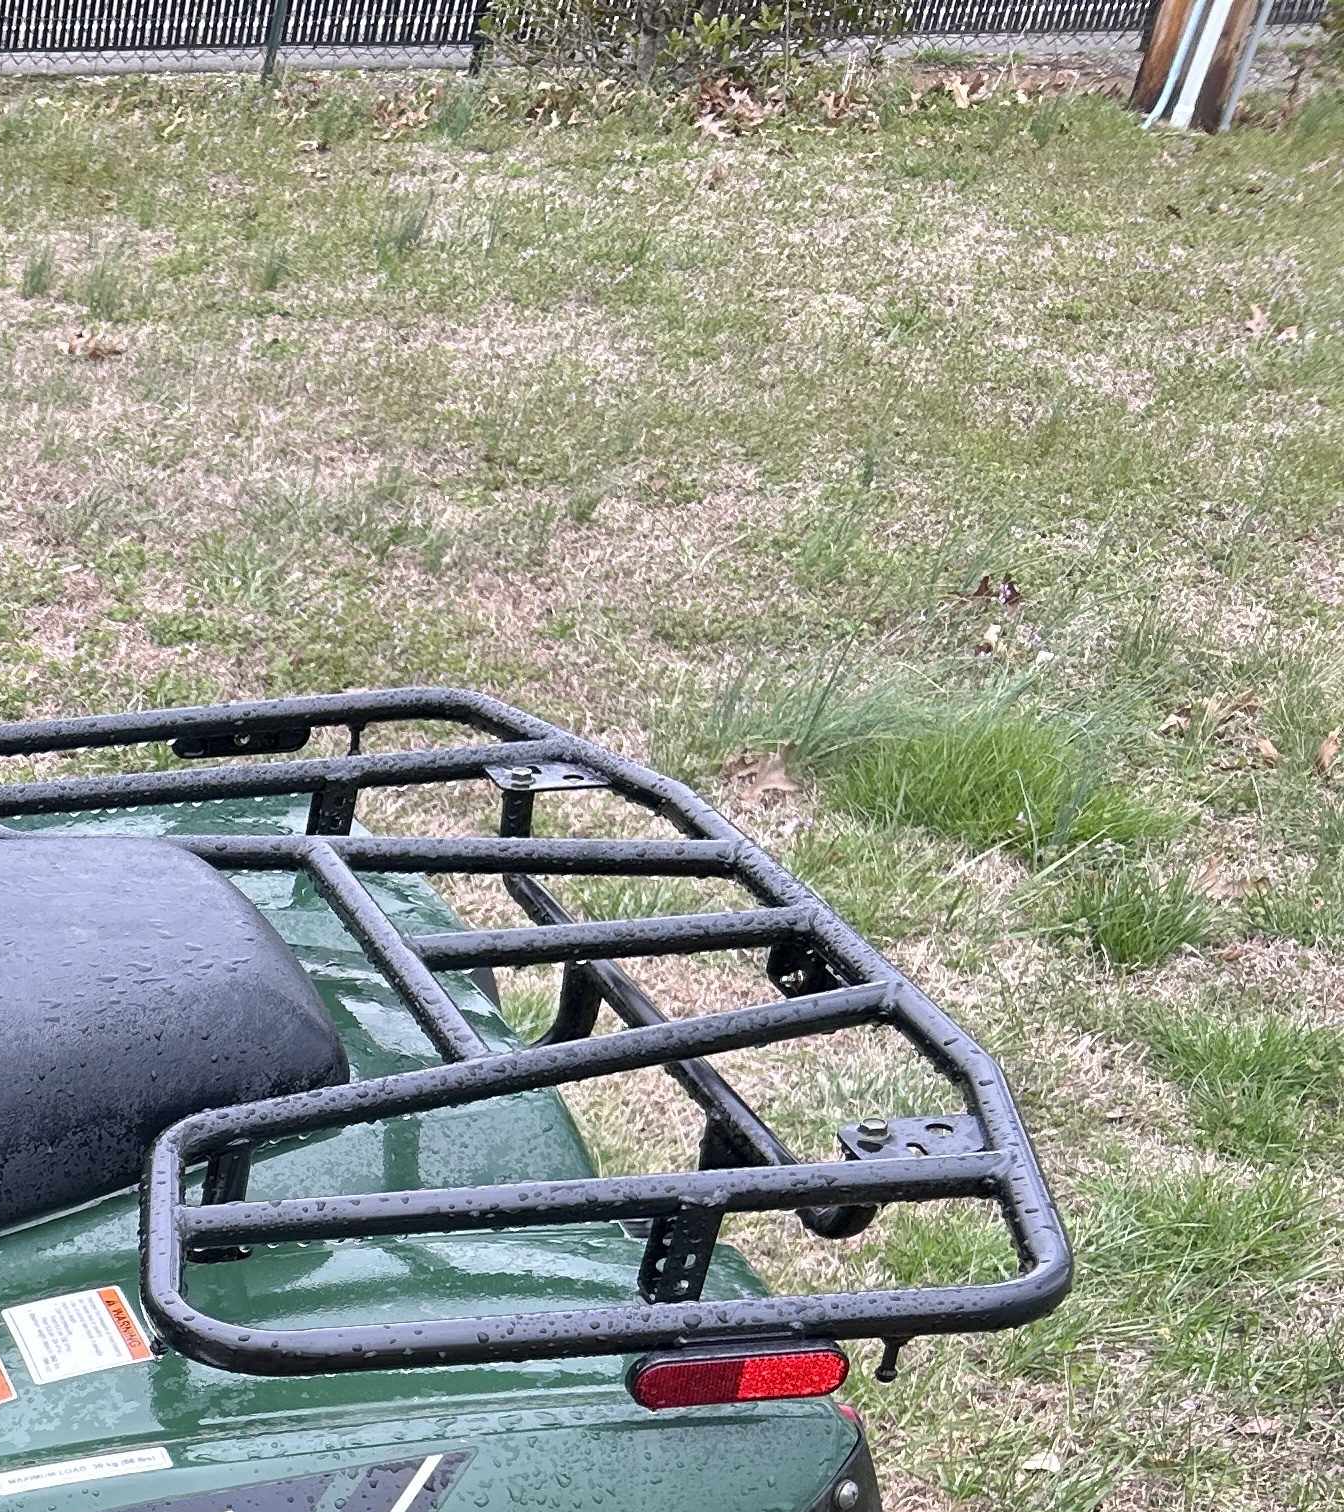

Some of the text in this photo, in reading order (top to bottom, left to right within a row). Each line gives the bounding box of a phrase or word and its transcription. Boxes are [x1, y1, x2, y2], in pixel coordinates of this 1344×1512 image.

[114, 1308, 141, 1348] WARNING
[7, 1471, 56, 1484] MAXIMUM
[59, 1465, 88, 1476] LOAD
